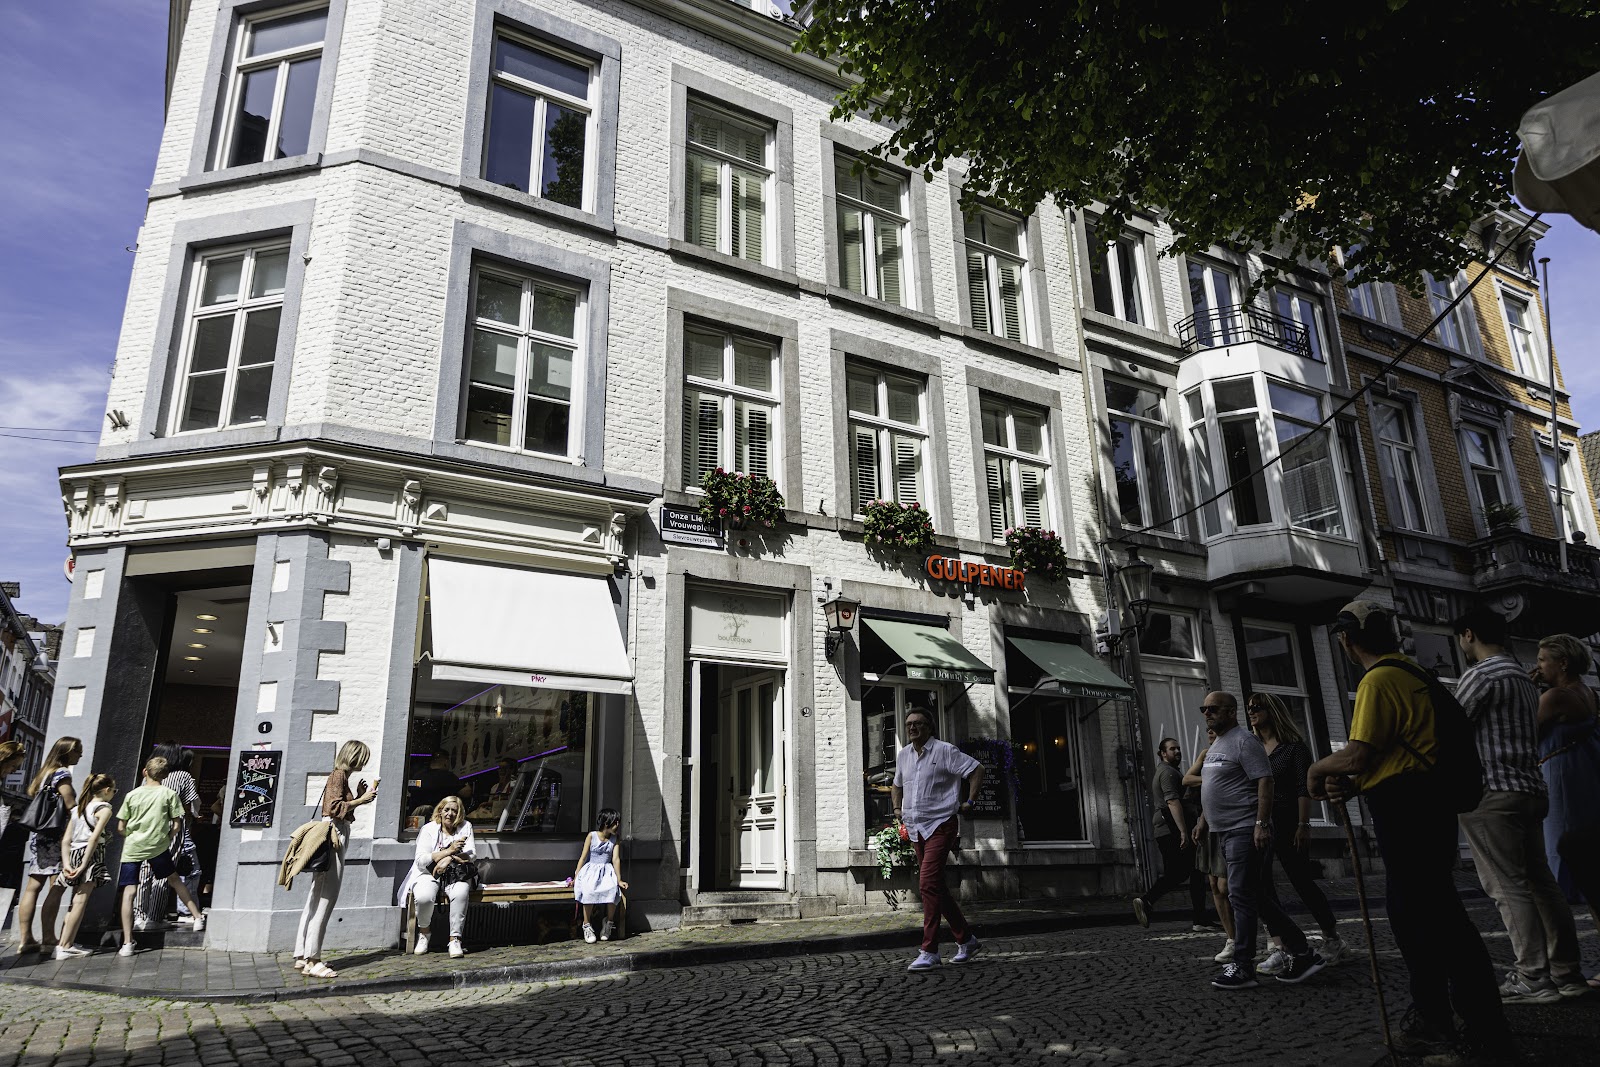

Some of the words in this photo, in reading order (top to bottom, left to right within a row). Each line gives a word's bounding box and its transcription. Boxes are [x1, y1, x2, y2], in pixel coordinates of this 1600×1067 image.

[670, 511, 689, 521] Onze
[669, 520, 715, 533] Vrouweplein
[926, 554, 1025, 591] GULPENER
